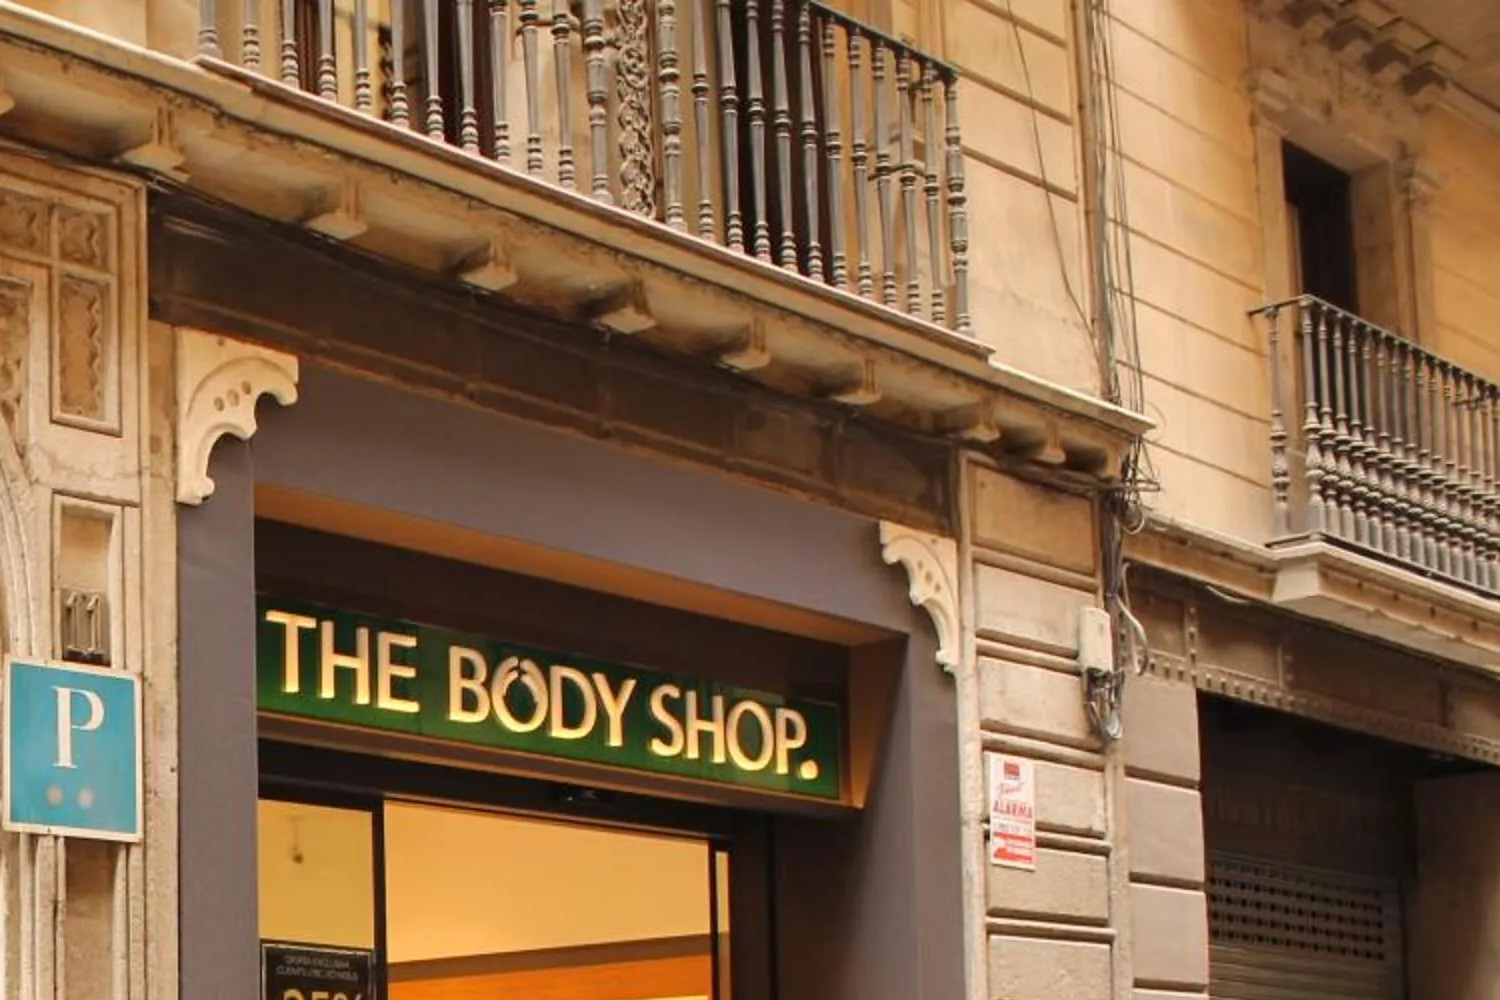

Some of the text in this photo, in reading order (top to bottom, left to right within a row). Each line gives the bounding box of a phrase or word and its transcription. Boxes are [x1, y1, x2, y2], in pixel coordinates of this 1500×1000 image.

[50, 684, 106, 770] P
[265, 609, 421, 714] THE
[447, 643, 638, 748] BODY
